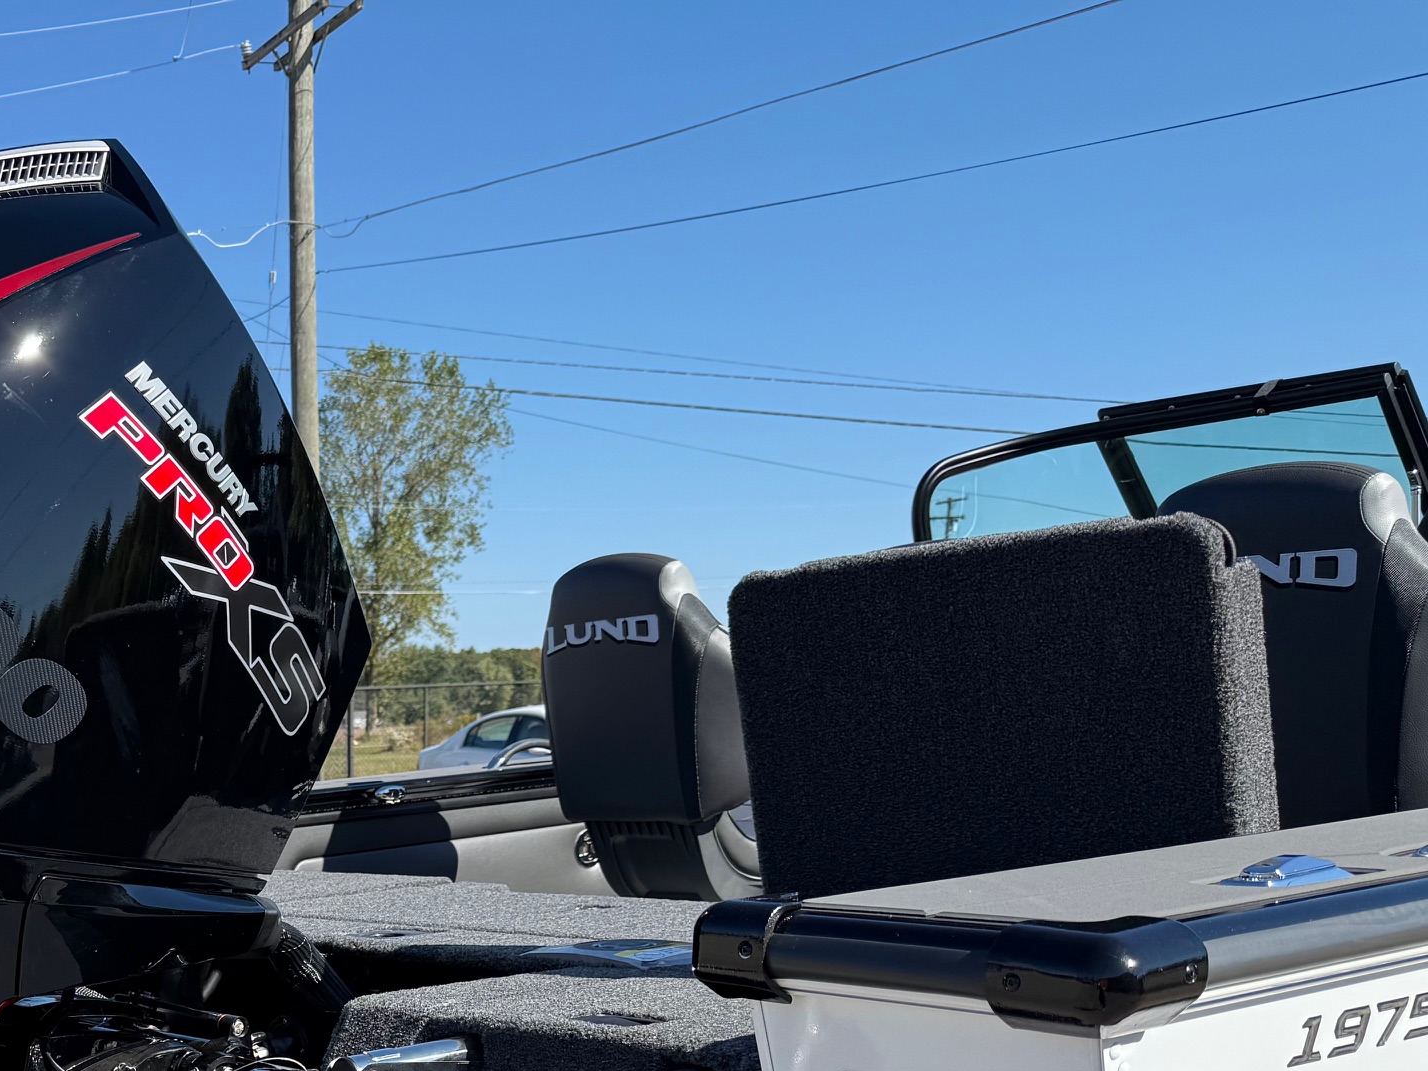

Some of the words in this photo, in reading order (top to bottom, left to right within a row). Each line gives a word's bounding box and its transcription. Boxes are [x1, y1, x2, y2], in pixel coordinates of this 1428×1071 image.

[78, 391, 255, 591] PRO
[124, 361, 258, 517] MERCURY
[161, 506, 326, 736] XS
[547, 614, 659, 655] LUND
